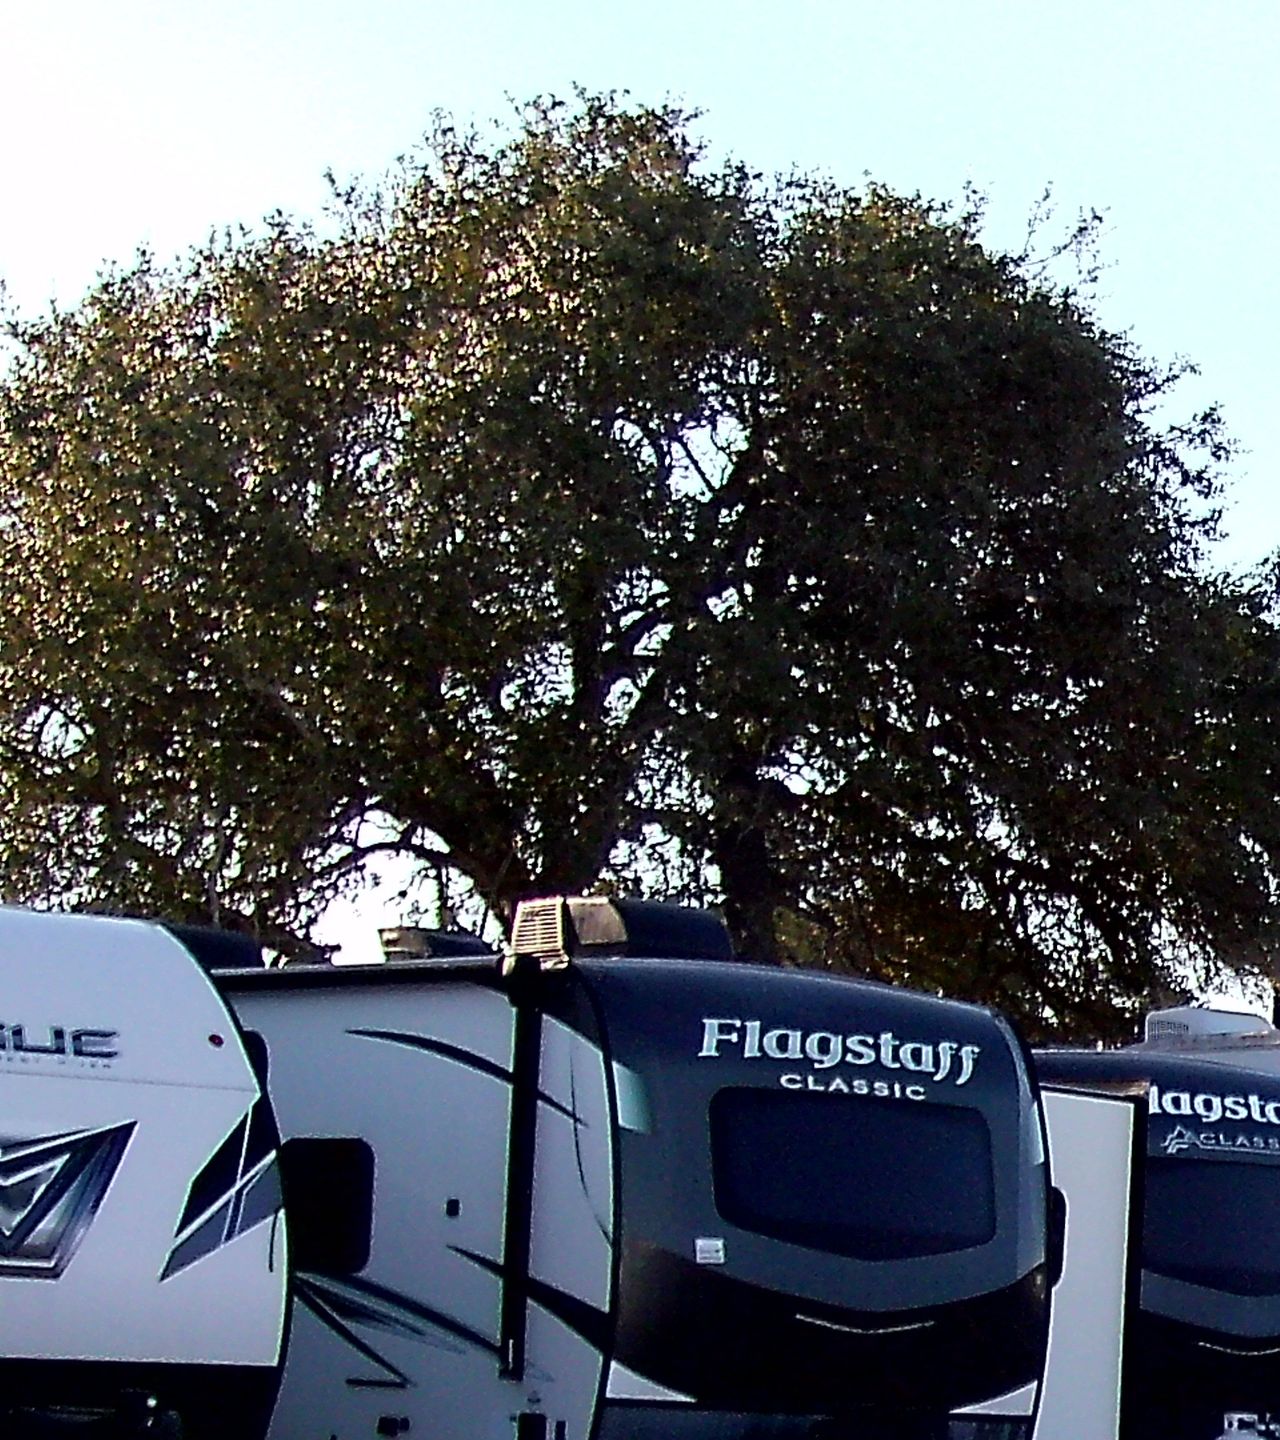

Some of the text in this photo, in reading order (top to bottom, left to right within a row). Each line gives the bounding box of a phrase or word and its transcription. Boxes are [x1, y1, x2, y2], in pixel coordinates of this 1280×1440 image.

[0, 1024, 118, 1058] UE
[698, 1018, 981, 1085] Flagstaff
[780, 1074, 927, 1100] CLASSIC
